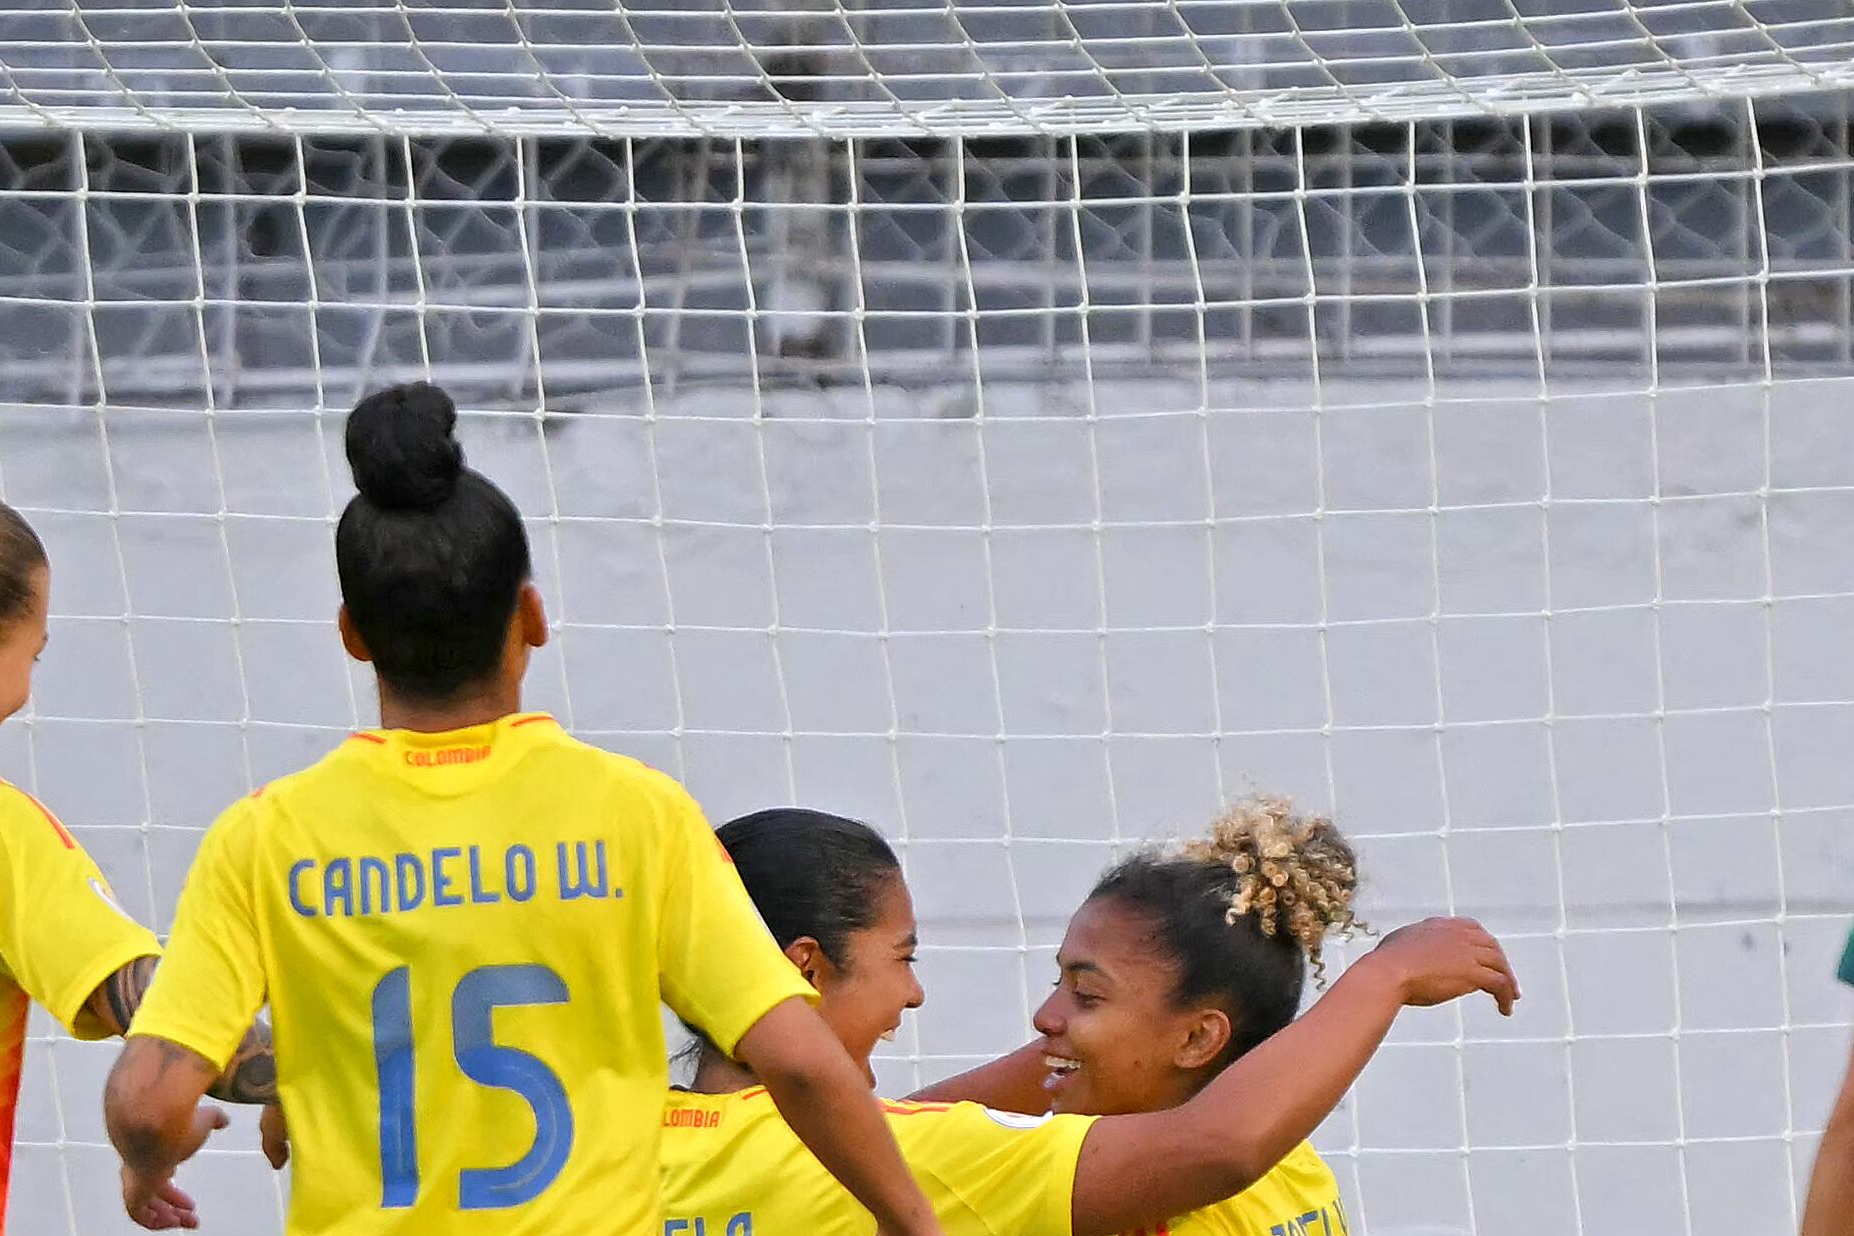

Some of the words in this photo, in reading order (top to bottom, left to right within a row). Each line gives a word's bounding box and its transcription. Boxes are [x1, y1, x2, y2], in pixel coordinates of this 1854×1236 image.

[404, 745, 492, 767] COLOMBIA
[288, 842, 537, 918] CANDELO
[557, 838, 625, 900] W.
[371, 962, 576, 1209] 15
